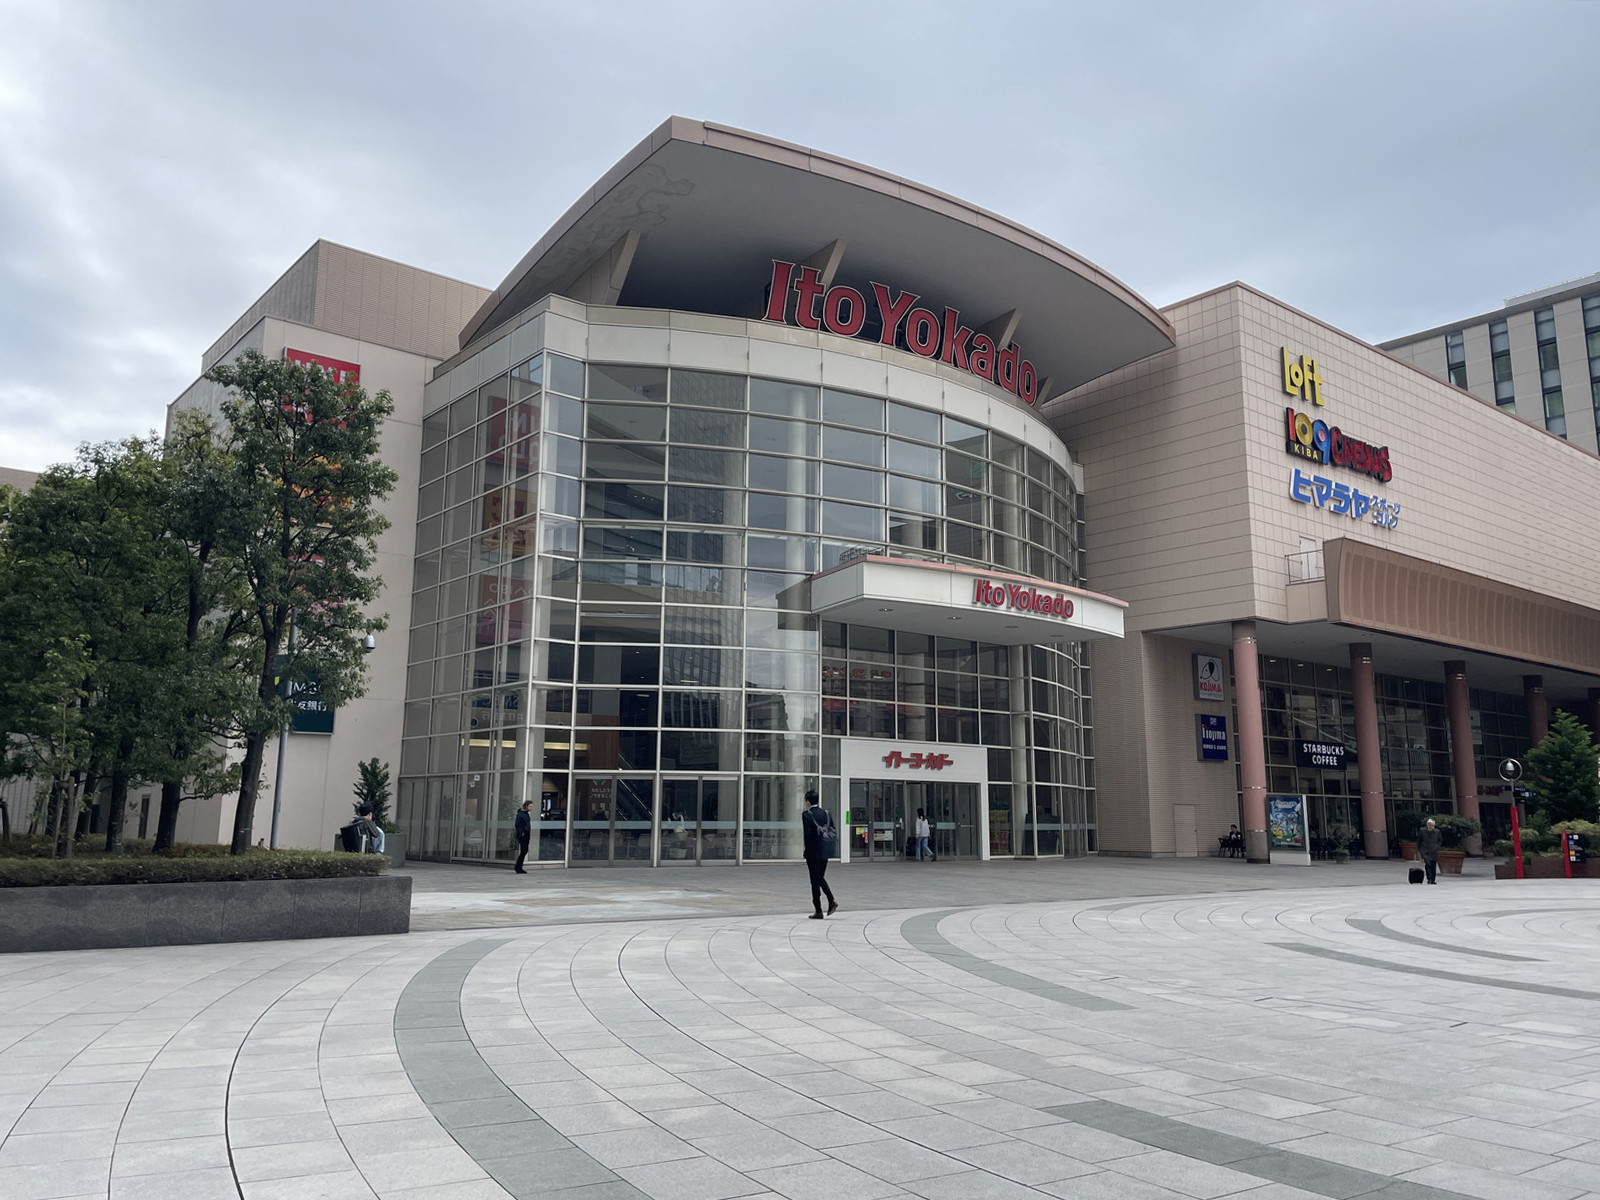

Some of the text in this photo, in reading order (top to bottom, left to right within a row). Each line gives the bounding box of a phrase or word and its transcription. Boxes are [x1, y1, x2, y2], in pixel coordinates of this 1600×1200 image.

[762, 259, 1038, 406] Ito Yokado
[1294, 443, 1319, 460] KIBA
[1329, 426, 1393, 483] CINEMAS
[1290, 468, 1370, 518] ヒマラヤ
[973, 579, 1074, 619] Ito Yokado
[882, 751, 954, 770] イトーヨーカドー
[1303, 743, 1345, 756] STARBUCKS
[1311, 755, 1338, 766] COFFEE
